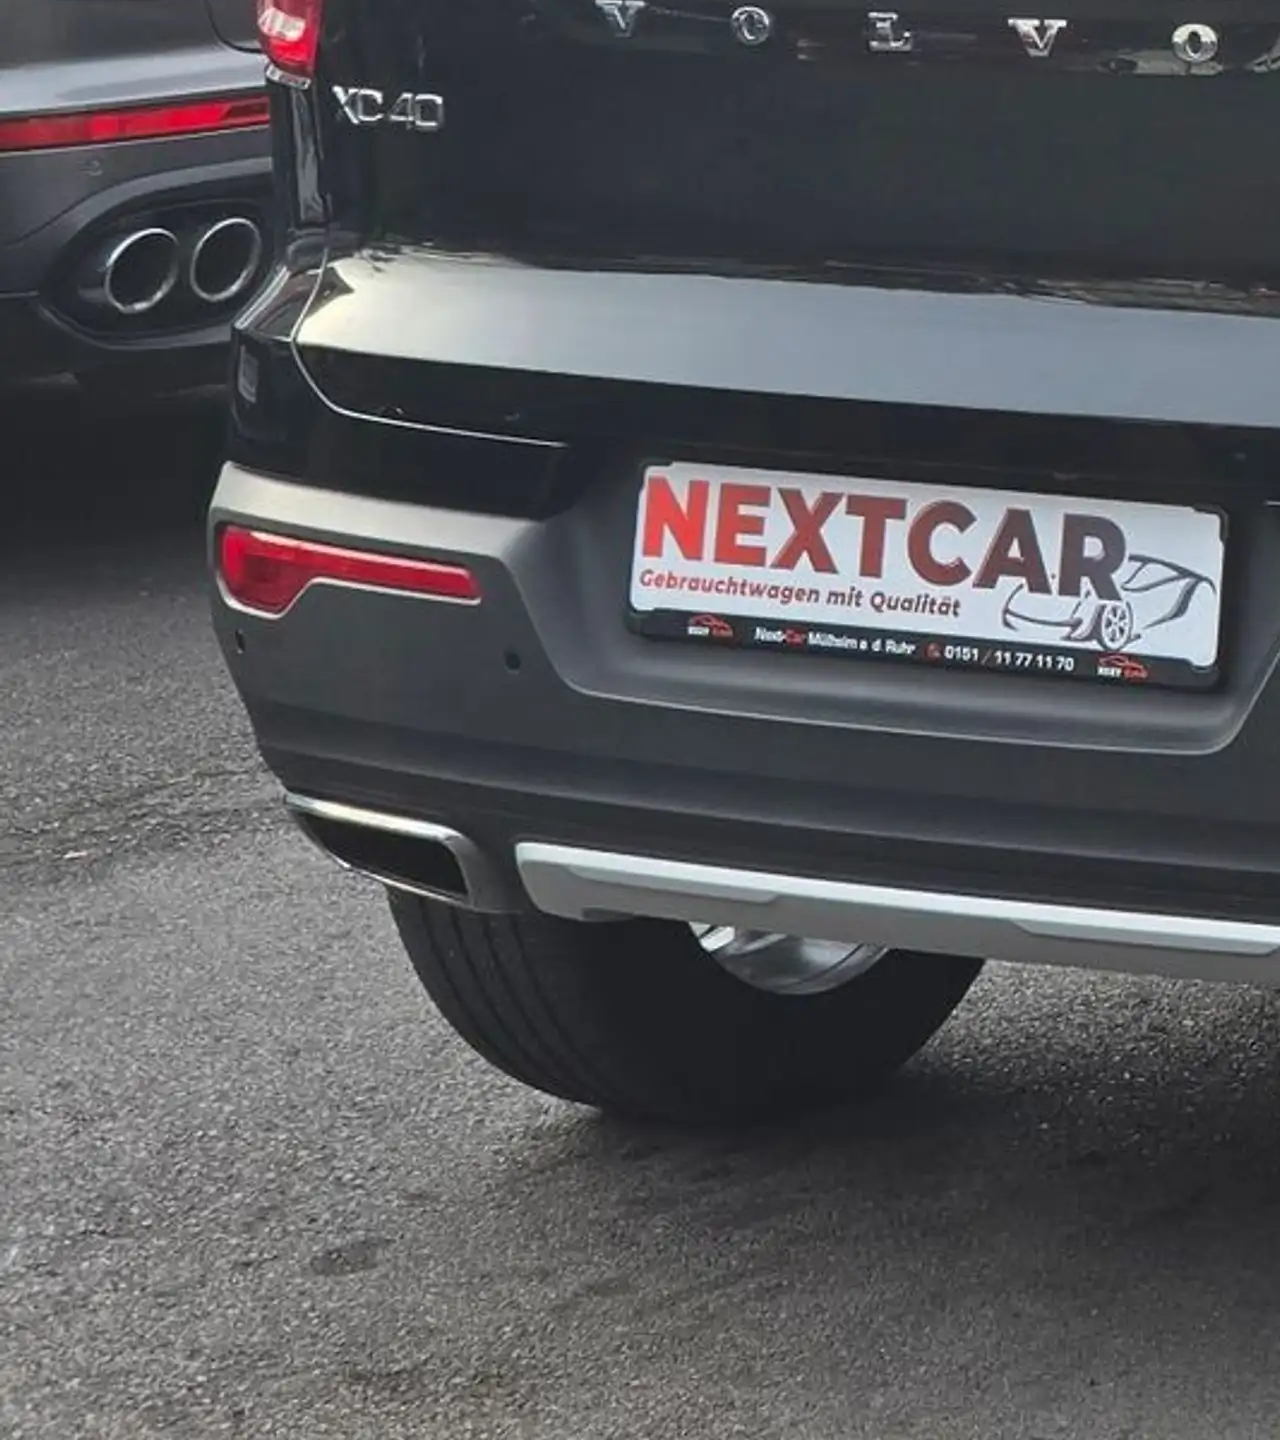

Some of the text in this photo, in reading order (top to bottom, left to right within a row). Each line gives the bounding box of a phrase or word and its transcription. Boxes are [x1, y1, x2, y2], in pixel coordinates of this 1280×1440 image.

[332, 85, 444, 131] XC40
[640, 476, 1128, 601] NEXTCAR
[639, 568, 961, 618] Gebrauchtwagen mit Qualität
[943, 644, 980, 662] 0151
